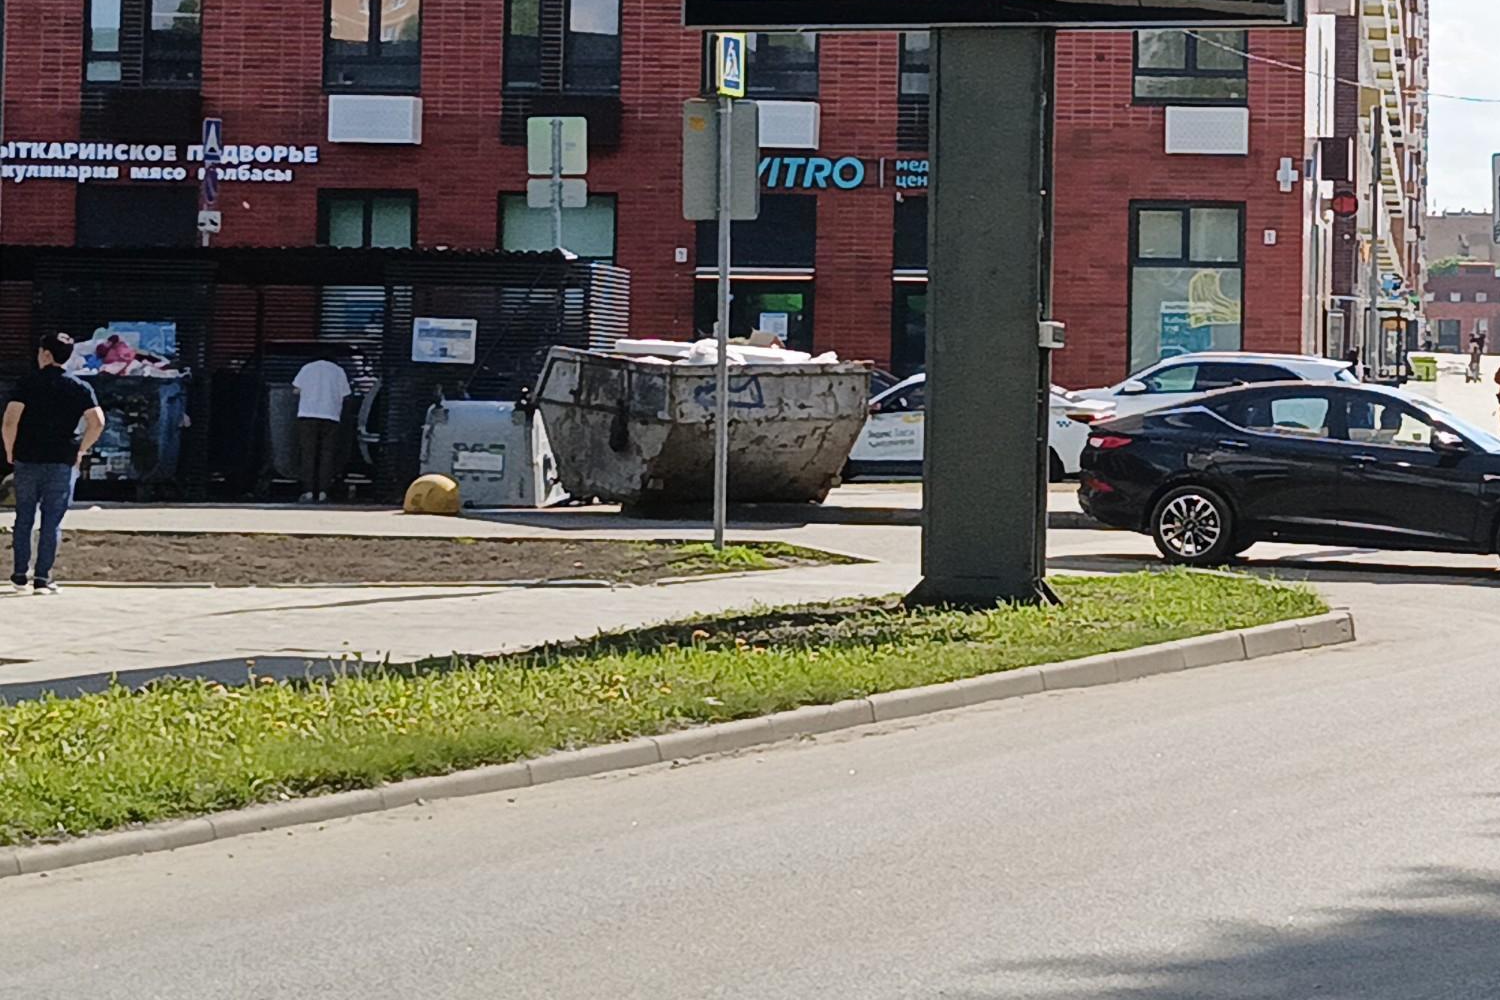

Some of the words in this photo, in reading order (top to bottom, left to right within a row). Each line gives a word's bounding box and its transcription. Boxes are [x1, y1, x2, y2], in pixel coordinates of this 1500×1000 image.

[187, 143, 318, 164] ПДВОРЬЕ
[1, 164, 119, 183] кулинария
[130, 167, 187, 181] мясо
